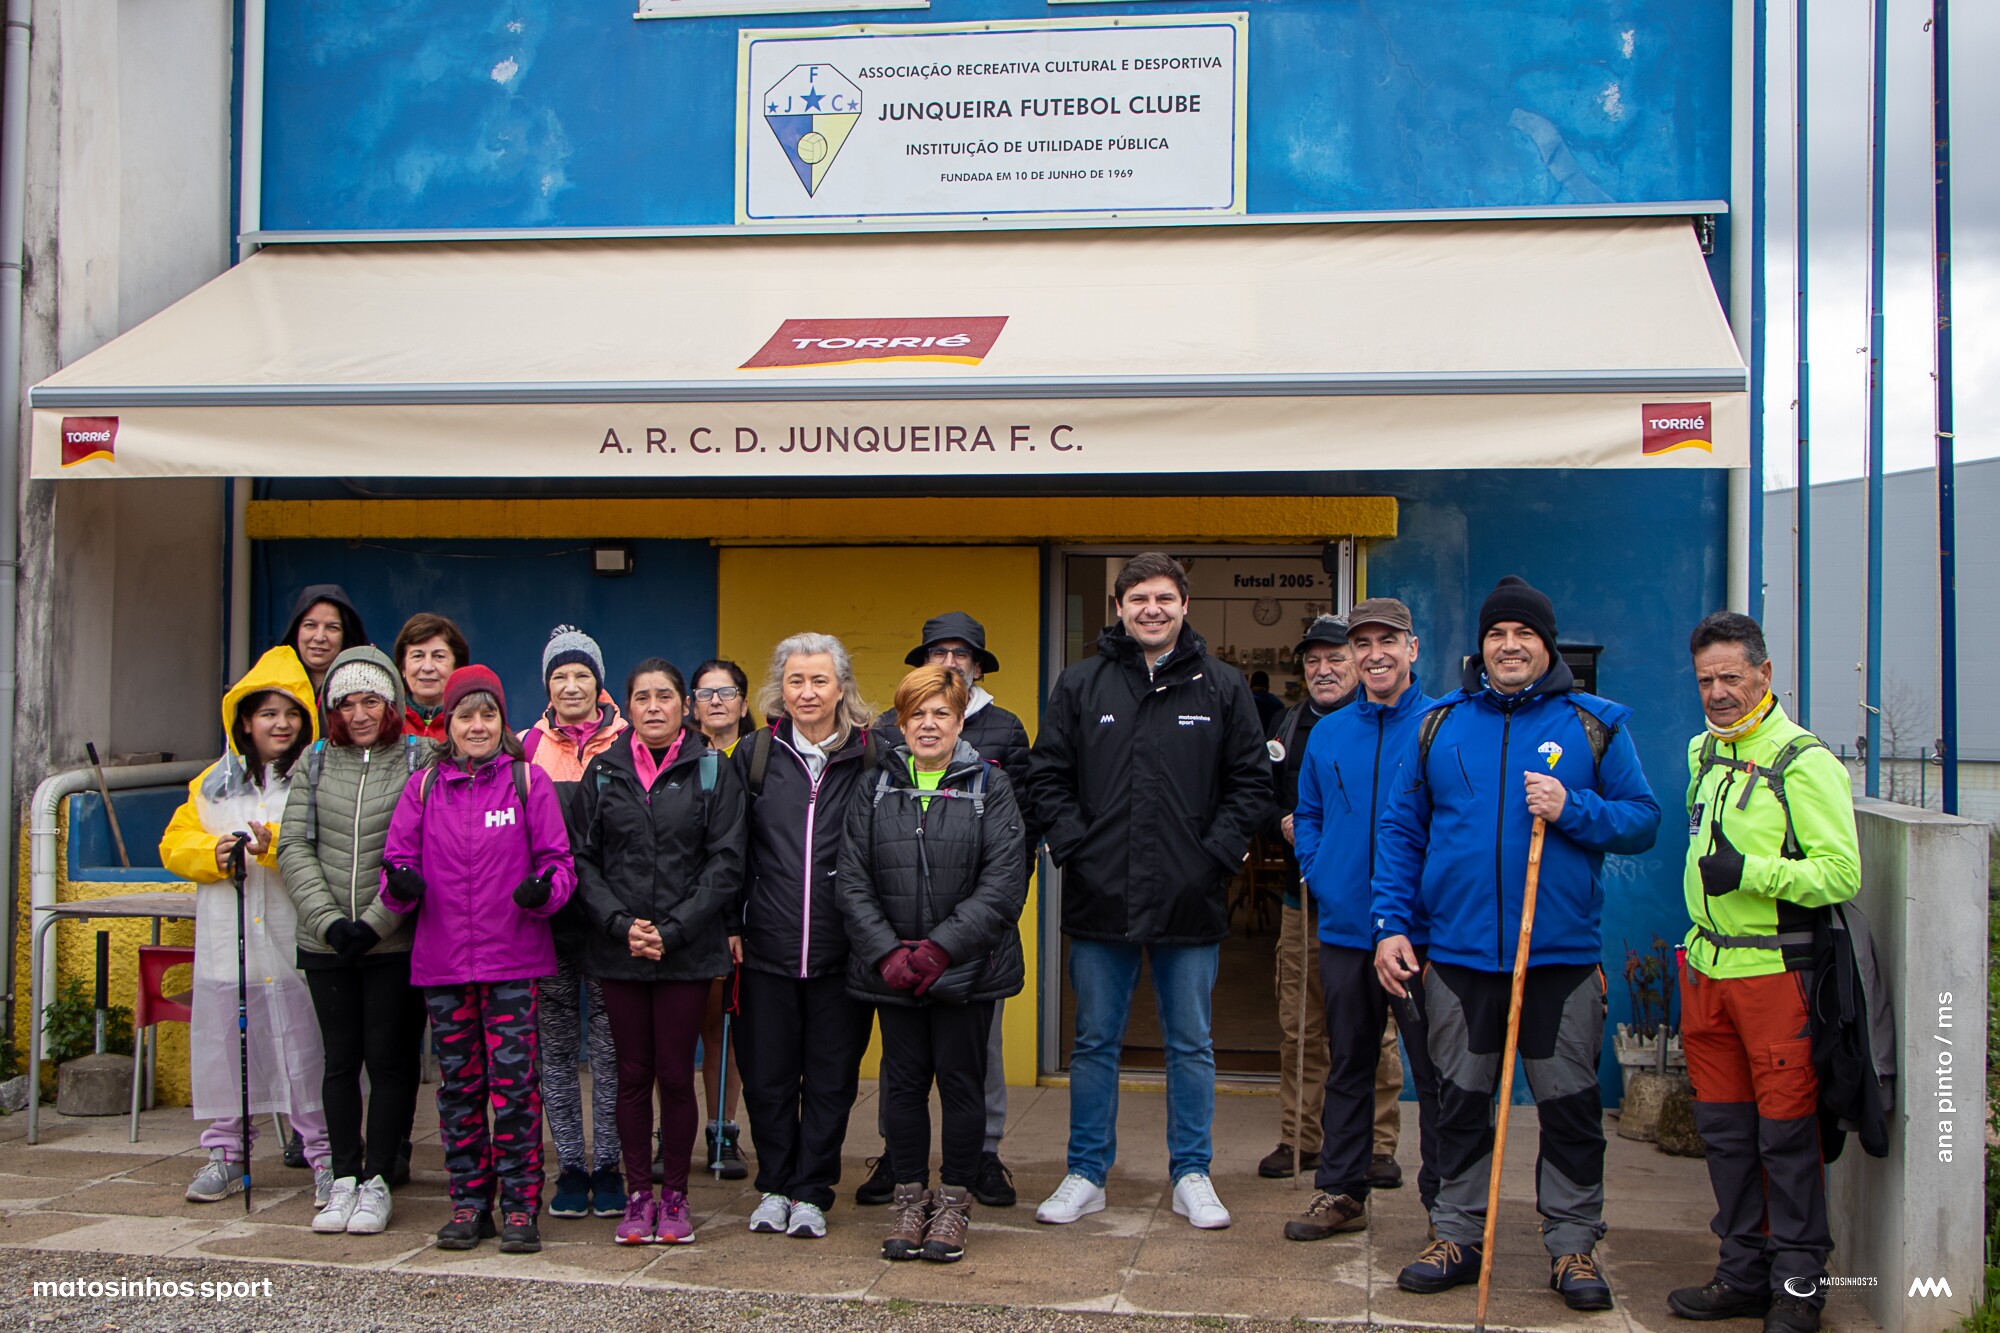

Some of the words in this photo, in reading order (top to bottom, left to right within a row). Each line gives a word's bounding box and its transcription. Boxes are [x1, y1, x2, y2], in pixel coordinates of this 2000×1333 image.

[809, 66, 819, 83] F
[858, 62, 951, 80] ASSOCIAÇÃO
[957, 61, 1041, 76] RECREATIVA
[1044, 60, 1117, 73] CULTURAL
[1121, 59, 1129, 71] E
[1134, 56, 1223, 71] DESPORTIVA
[878, 100, 1013, 122] JUNQUEIRA
[1020, 96, 1121, 117] FUTEBOL
[1128, 94, 1201, 115] CLUBE
[906, 138, 998, 158] INSTITUIÇÃO
[1004, 141, 1023, 153] DE
[1027, 139, 1103, 153] UTILIDADE
[1108, 135, 1169, 151] PÚBLICA
[940, 172, 994, 183] FUNDADA
[996, 171, 1012, 181] EM
[1015, 171, 1028, 181] 10
[1031, 170, 1045, 180] DE
[1047, 170, 1087, 180] JUNHO
[1090, 169, 1104, 179] DE
[1108, 169, 1134, 179] 1969
[599, 427, 632, 454] A.
[646, 427, 676, 454] R.
[689, 426, 721, 454] C.
[735, 427, 766, 453] D.
[778, 424, 996, 453] JUNQUEIRA
[1010, 425, 1036, 452] F.
[1050, 424, 1083, 452] C.
[1234, 573, 1275, 587] Futsal
[1279, 574, 1314, 587] 2005
[485, 807, 516, 828] HH
